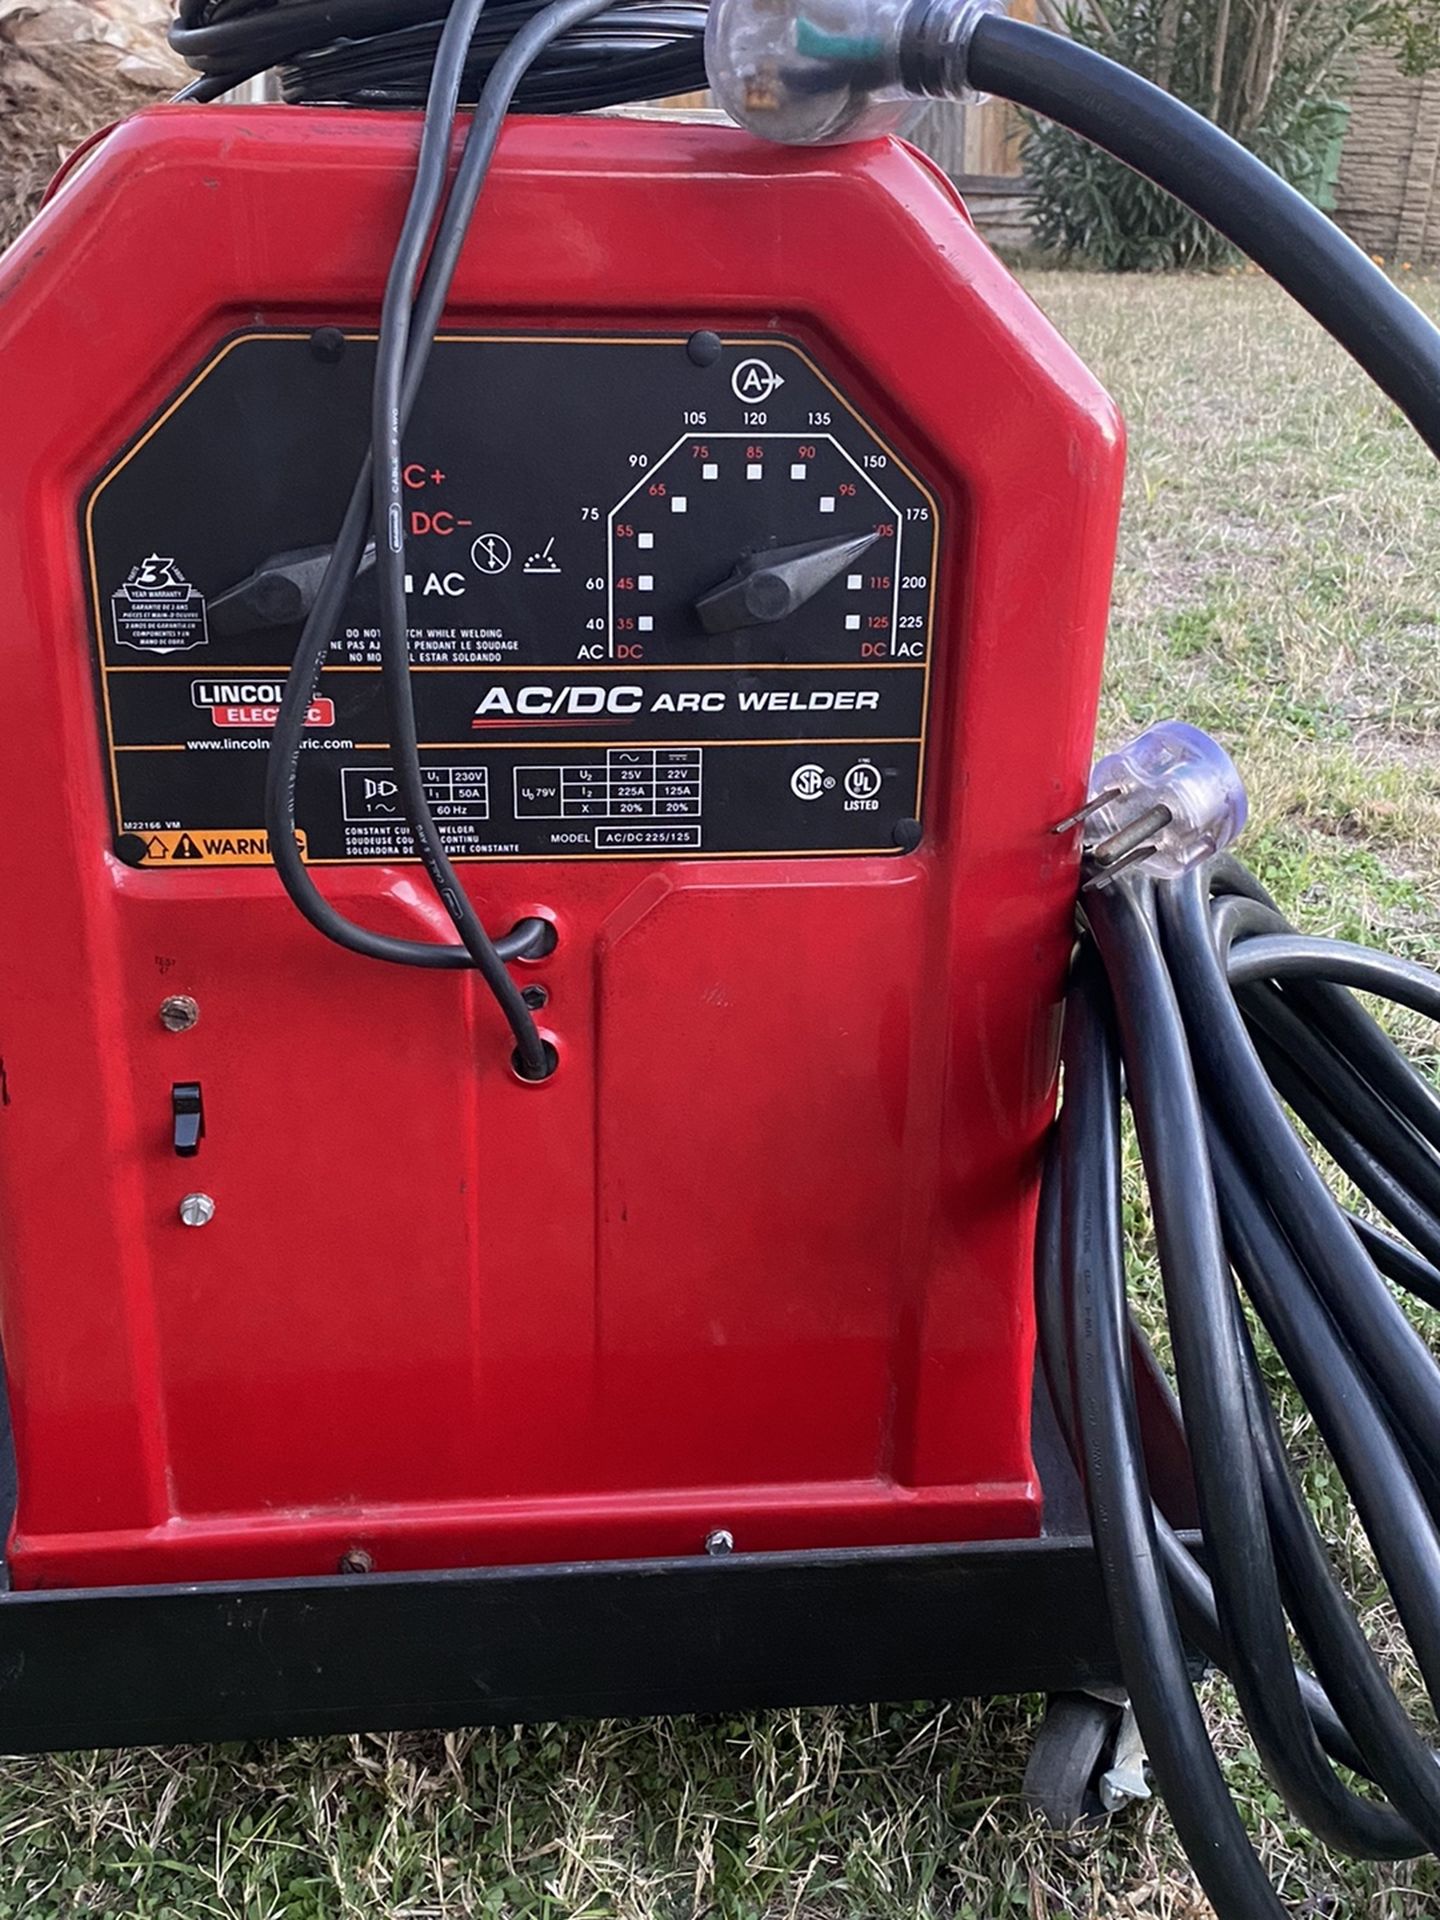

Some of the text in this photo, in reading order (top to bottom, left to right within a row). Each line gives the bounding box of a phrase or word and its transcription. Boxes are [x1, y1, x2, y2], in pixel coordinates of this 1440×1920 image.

[683, 411, 832, 426] 105 120 135
[692, 445, 816, 459] 75 85 90
[628, 454, 648, 468] 90
[863, 454, 887, 469] 150
[648, 483, 666, 497] 65
[839, 483, 857, 497] 95
[581, 507, 600, 521] 75
[906, 507, 929, 521] 175
[616, 524, 634, 538] 55
[875, 523, 895, 538] 05
[136, 559, 173, 589] 3
[422, 572, 466, 596] AC
[585, 577, 605, 591] 60
[616, 577, 634, 590] 45
[870, 576, 891, 589] 115
[901, 575, 927, 589] 200
[585, 617, 605, 631] 40
[617, 617, 634, 630] 35
[868, 616, 889, 629] 125
[898, 615, 924, 629] 225
[345, 628, 360, 639] DO
[426, 628, 456, 639] WHILE
[459, 628, 503, 639] WELDING
[330, 640, 343, 650] NE
[346, 640, 366, 650] PAS
[414, 640, 457, 651] PENDANT
[460, 640, 472, 651] LE
[475, 640, 519, 651] SOUDAGE
[576, 644, 604, 660] AC
[617, 643, 643, 660] DC
[861, 642, 887, 658] DC
[896, 641, 924, 657] AC
[348, 652, 363, 663] NO
[419, 652, 449, 663] ESTAR
[452, 652, 502, 663] SOLDANDO
[199, 684, 283, 703] LINCOL
[474, 685, 880, 715] AC/DC ARC WELDER
[454, 771, 483, 782] 230V
[621, 770, 642, 780] 25V
[667, 769, 688, 779] 22V
[458, 788, 480, 799] 50A
[535, 787, 556, 798] 79V
[617, 786, 646, 797] 225A
[664, 786, 691, 796] 125A
[436, 805, 468, 816] 60 Hz
[581, 802, 689, 814] X 20% 20%
[843, 799, 879, 811] LISTED
[165, 821, 181, 829] VM
[344, 826, 391, 836] CONSTANT
[438, 825, 475, 834] WELDER
[345, 836, 392, 846] SOUDEUSE
[439, 835, 480, 844] CONTINU
[550, 833, 591, 844] MODEL
[346, 846, 400, 856] SOLDADORA
[469, 844, 519, 853] CONSTANTE
